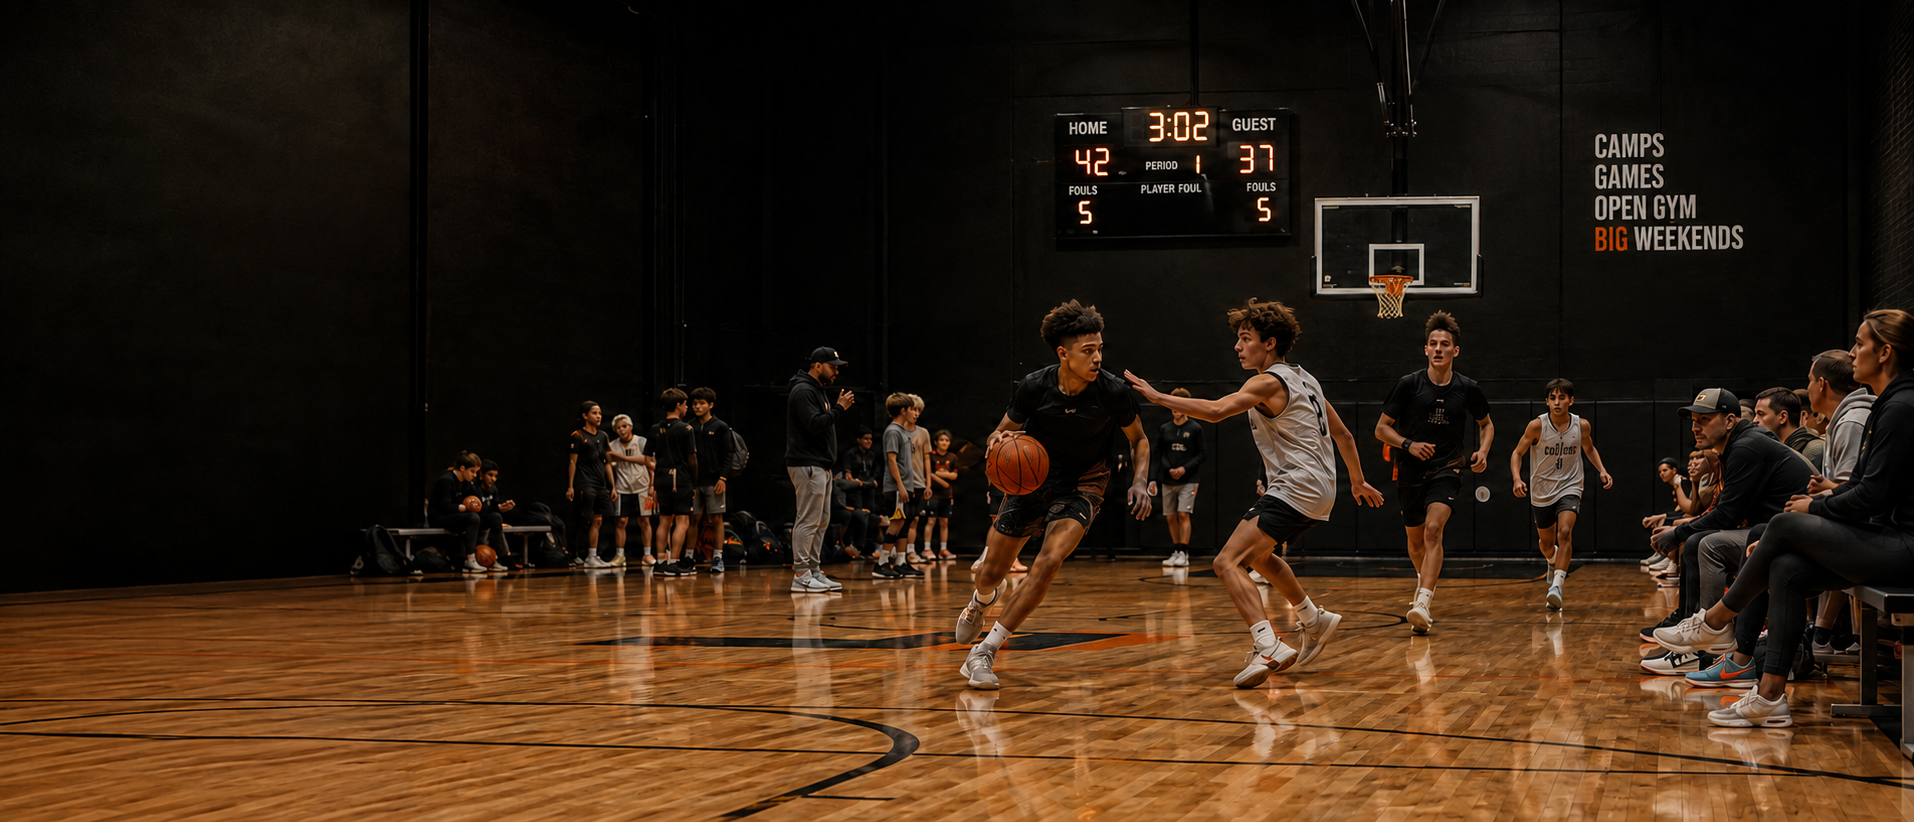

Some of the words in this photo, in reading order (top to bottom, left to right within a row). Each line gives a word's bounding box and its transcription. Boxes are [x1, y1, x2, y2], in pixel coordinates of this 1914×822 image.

[1069, 121, 1108, 135] HOME
[1149, 110, 1209, 142] 3:02
[1232, 117, 1277, 132] GUEST
[1594, 132, 1665, 159] CAMPS
[1075, 147, 1110, 176] 42
[1145, 160, 1179, 171] PERIOD
[1195, 154, 1201, 174] 1
[1239, 144, 1274, 174] 37
[1140, 183, 1176, 194] PLAYER
[1178, 182, 1202, 194] FOUL
[1246, 181, 1277, 192] FOULS
[1594, 163, 1665, 190] GAMES
[1068, 185, 1098, 196] FOULS
[1078, 200, 1092, 224] 5
[1257, 197, 1271, 222] 5
[1594, 194, 1647, 221] OPEN
[1653, 194, 1697, 220] GYM
[1594, 226, 1628, 252] BIG
[1633, 224, 1744, 251] WEEKENDS
